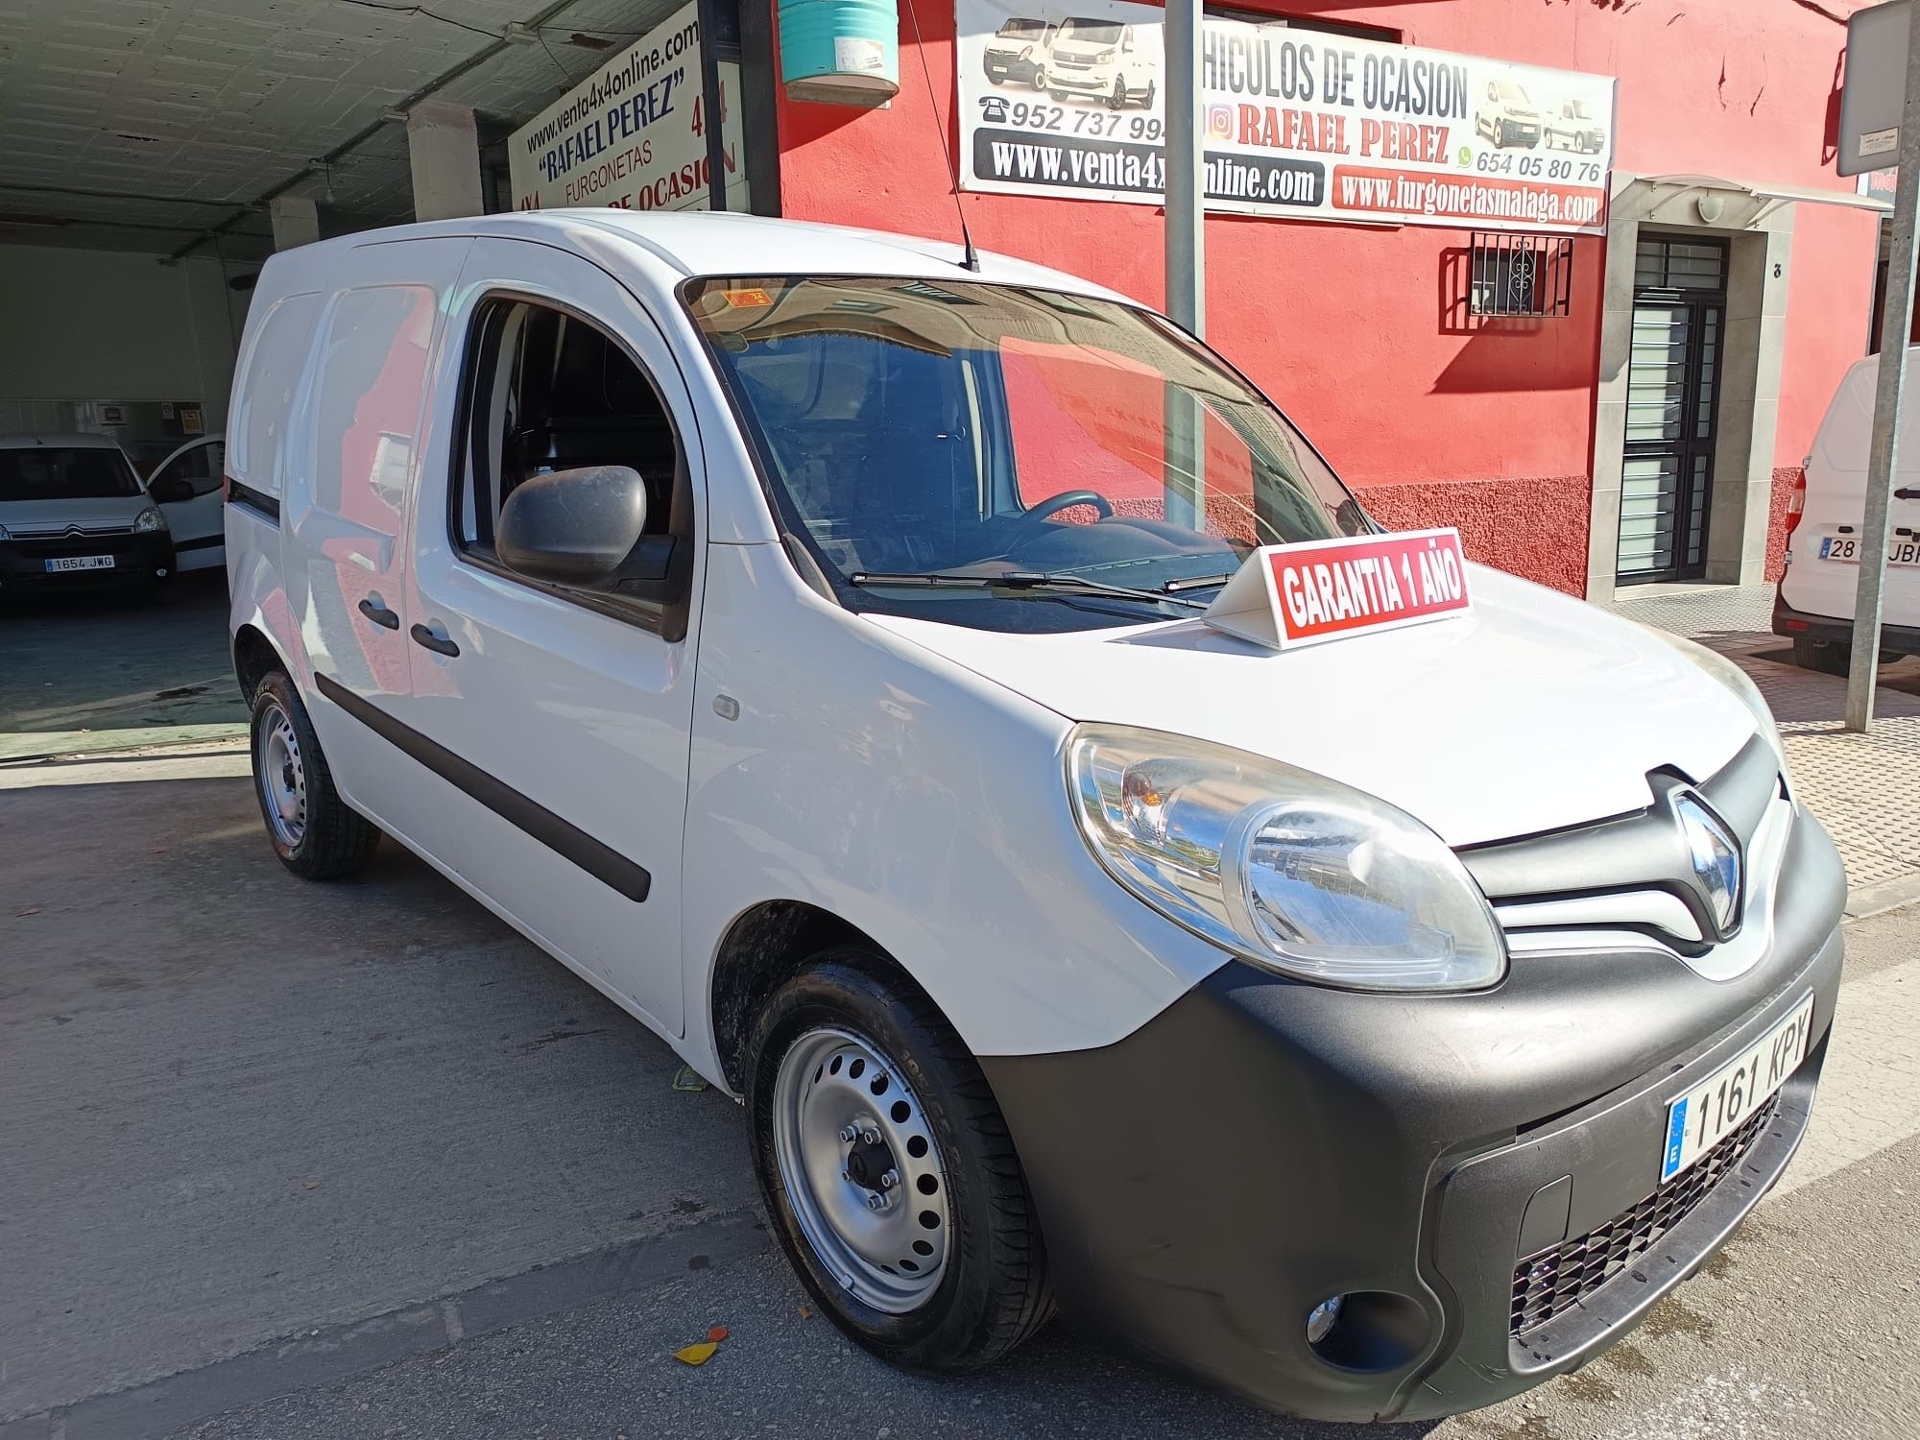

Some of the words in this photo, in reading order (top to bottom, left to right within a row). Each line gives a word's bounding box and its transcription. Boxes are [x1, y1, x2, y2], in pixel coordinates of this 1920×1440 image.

[527, 20, 699, 154] www.venta4x4online.com
[1323, 47, 1355, 107] DE
[1363, 53, 1467, 119] OCASION
[1011, 102, 1064, 132] 952
[1074, 109, 1122, 138] 737
[1129, 116, 1166, 141] 99
[1238, 103, 1351, 155] RAFAEL
[1360, 118, 1450, 164] PEREZ
[566, 139, 652, 204] FURGONETAS
[1476, 151, 1512, 174] 654
[1518, 156, 1542, 177] 05
[1548, 159, 1572, 180] 80
[1578, 162, 1601, 182] 76
[1341, 174, 1598, 223] www.furgonetasmalaga.com
[1773, 263, 1782, 279] 3
[56, 559, 85, 569] 1654
[90, 557, 112, 567] JWG
[1283, 556, 1405, 629] GARANTIA
[1402, 552, 1419, 608] 1
[1418, 538, 1462, 605] AÑO
[1698, 1054, 1760, 1149] 1161
